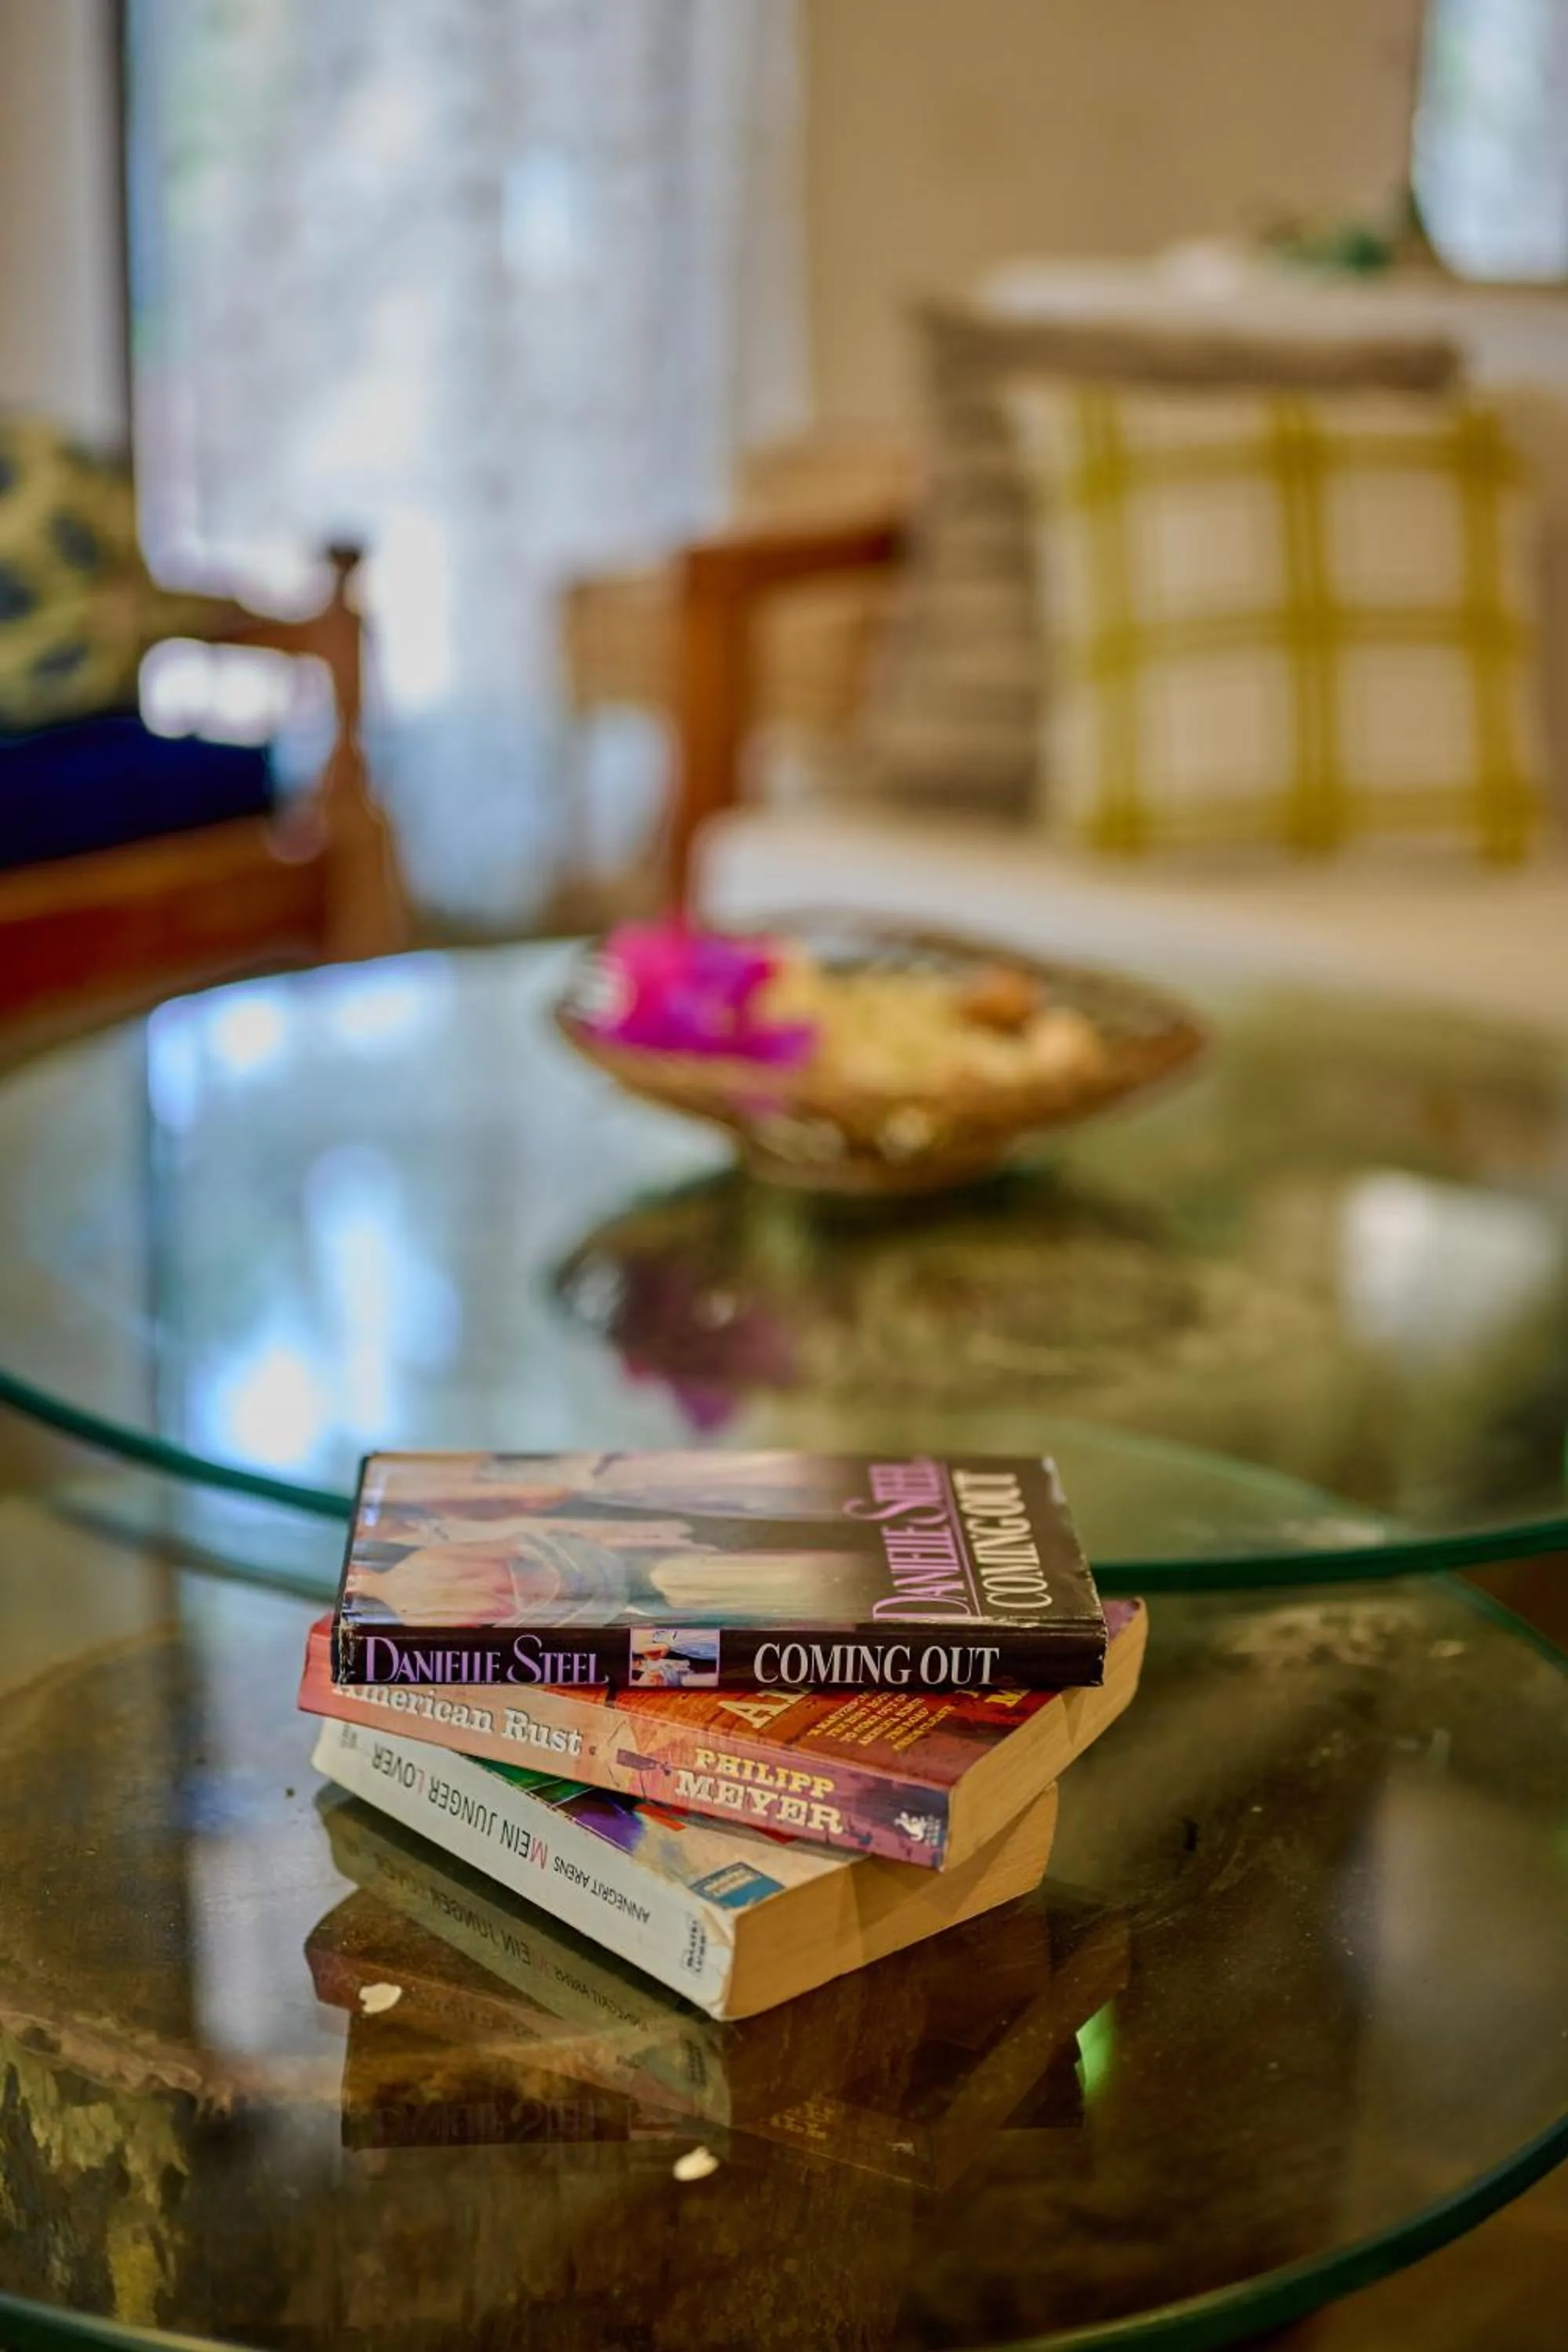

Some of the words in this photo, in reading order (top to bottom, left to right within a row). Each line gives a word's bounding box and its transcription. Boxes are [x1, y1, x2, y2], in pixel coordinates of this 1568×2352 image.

[952, 1469, 1025, 1517] OUT
[873, 1526, 971, 1620] DANIELLE
[965, 1517, 1052, 1609] COMING
[365, 1635, 501, 1684] DANIELLE
[506, 1635, 609, 1685] STEEL
[753, 1642, 911, 1685] COMING
[920, 1646, 1000, 1686] OUT
[502, 1707, 583, 1757] Rust
[372, 1741, 425, 1795] LOVER
[693, 1748, 835, 1799] PHILIPP
[428, 1775, 498, 1837] JUNGER
[675, 1770, 844, 1835] MEYER
[499, 1819, 548, 1870] MEIN
[554, 1856, 592, 1891] ARENS
[591, 1879, 650, 1924] ANNEGRIT
